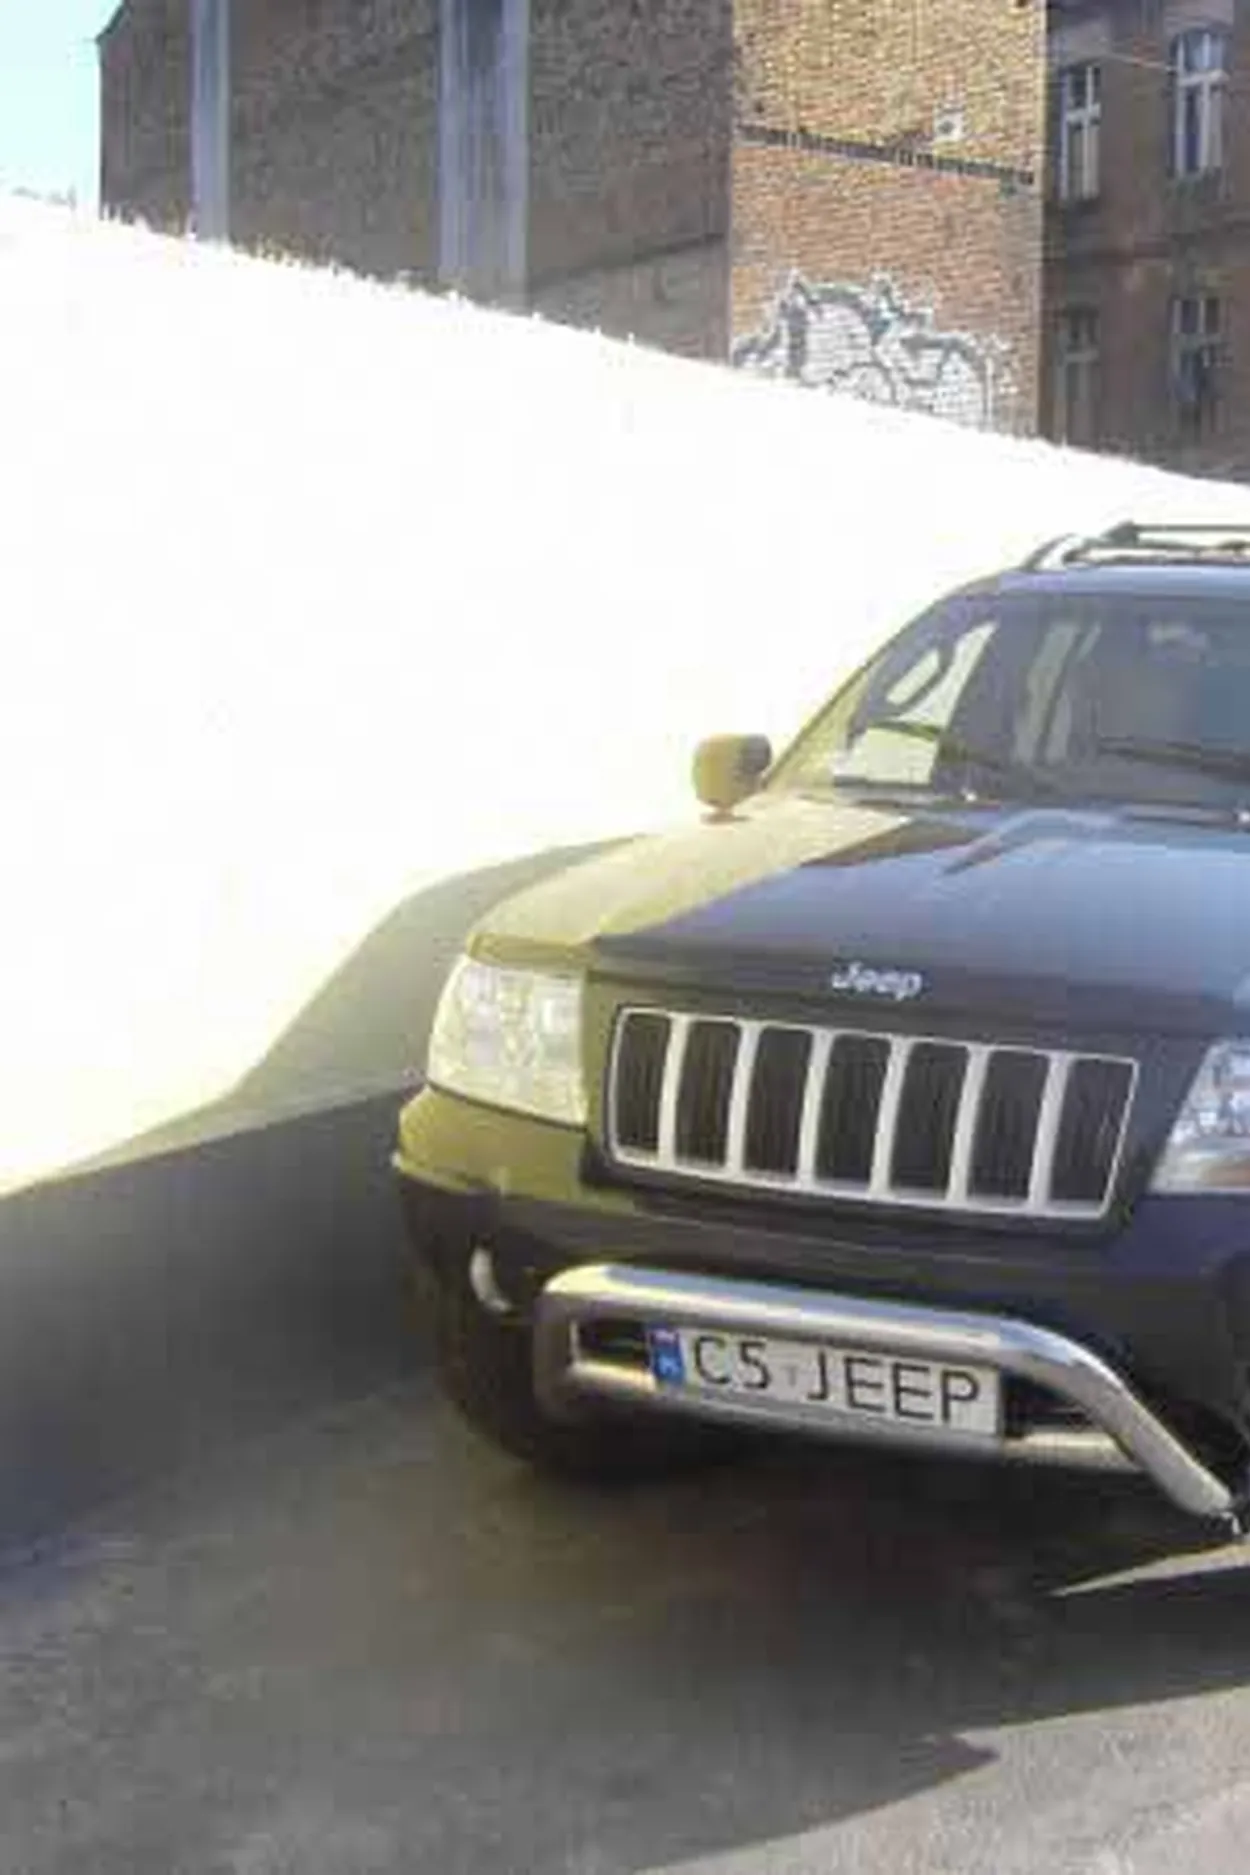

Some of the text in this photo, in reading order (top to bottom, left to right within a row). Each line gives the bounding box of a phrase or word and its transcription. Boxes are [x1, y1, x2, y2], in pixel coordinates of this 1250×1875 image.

[831, 961, 924, 1002] Jeep
[693, 1334, 982, 1424] C5 JEEP
